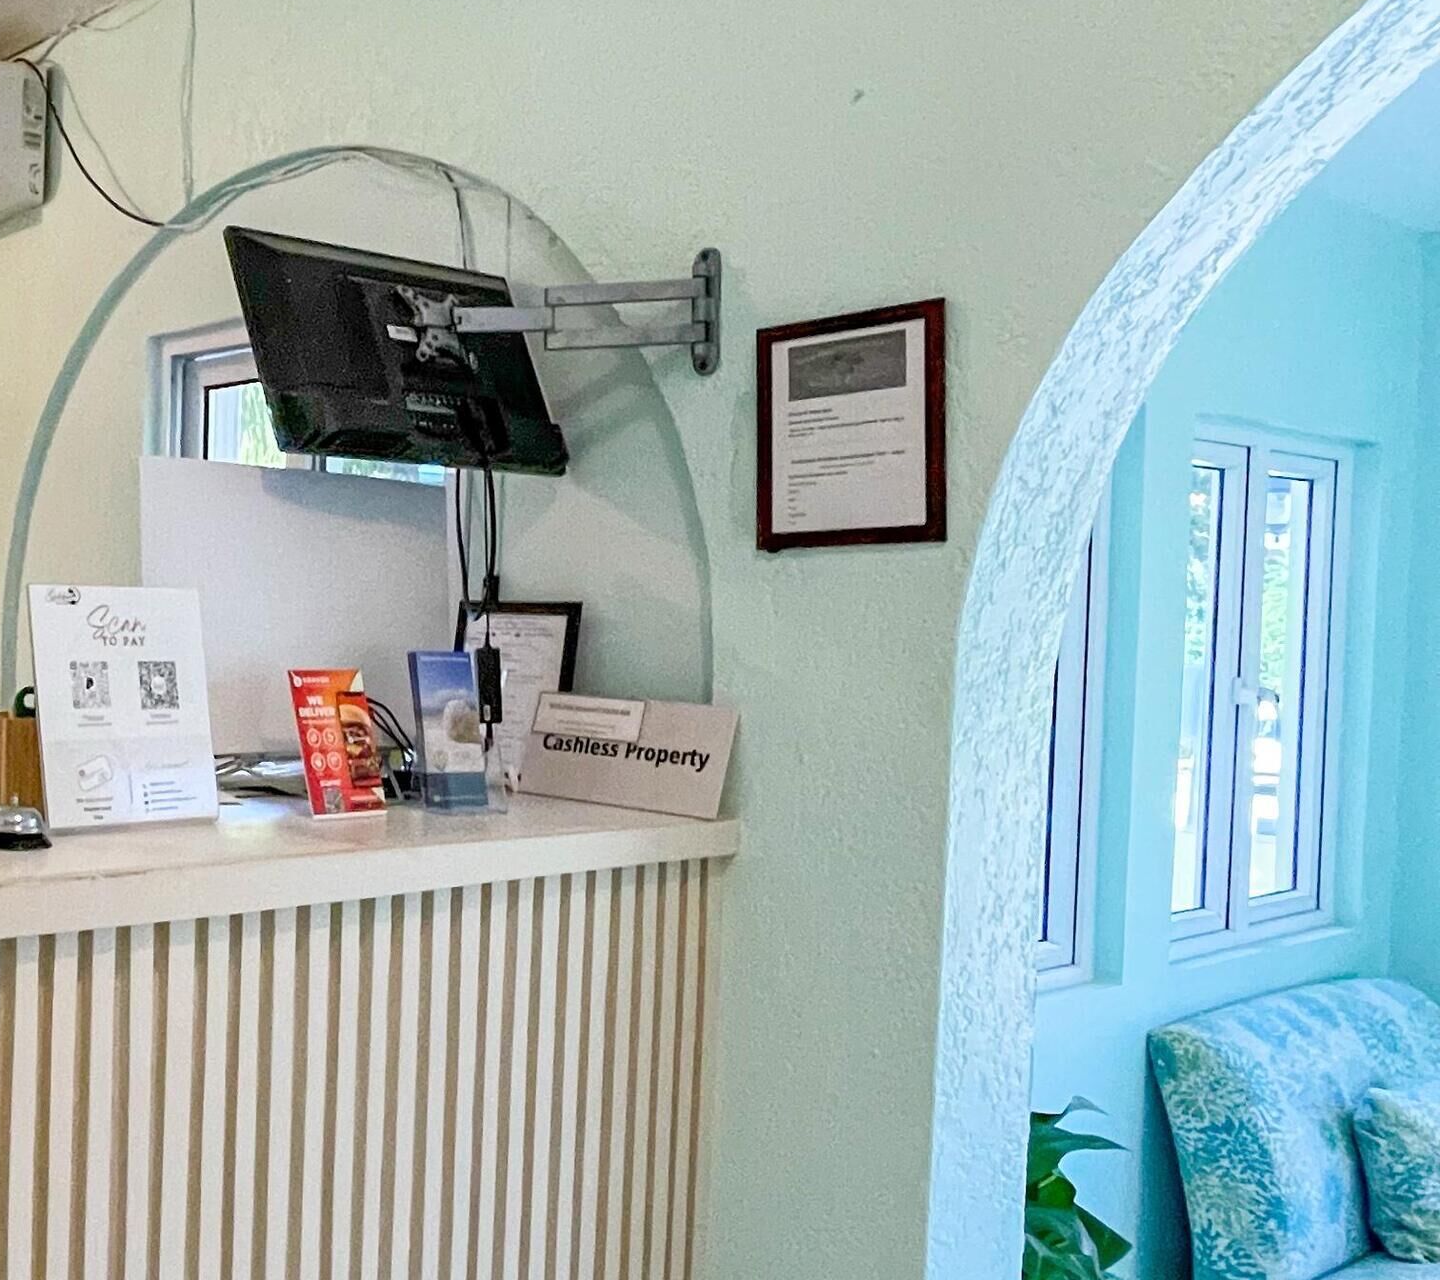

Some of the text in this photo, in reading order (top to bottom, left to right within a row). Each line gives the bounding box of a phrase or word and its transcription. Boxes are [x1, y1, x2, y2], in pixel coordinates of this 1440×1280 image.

[102, 636, 145, 646] TO PAY
[543, 733, 710, 773] Cashless Property
